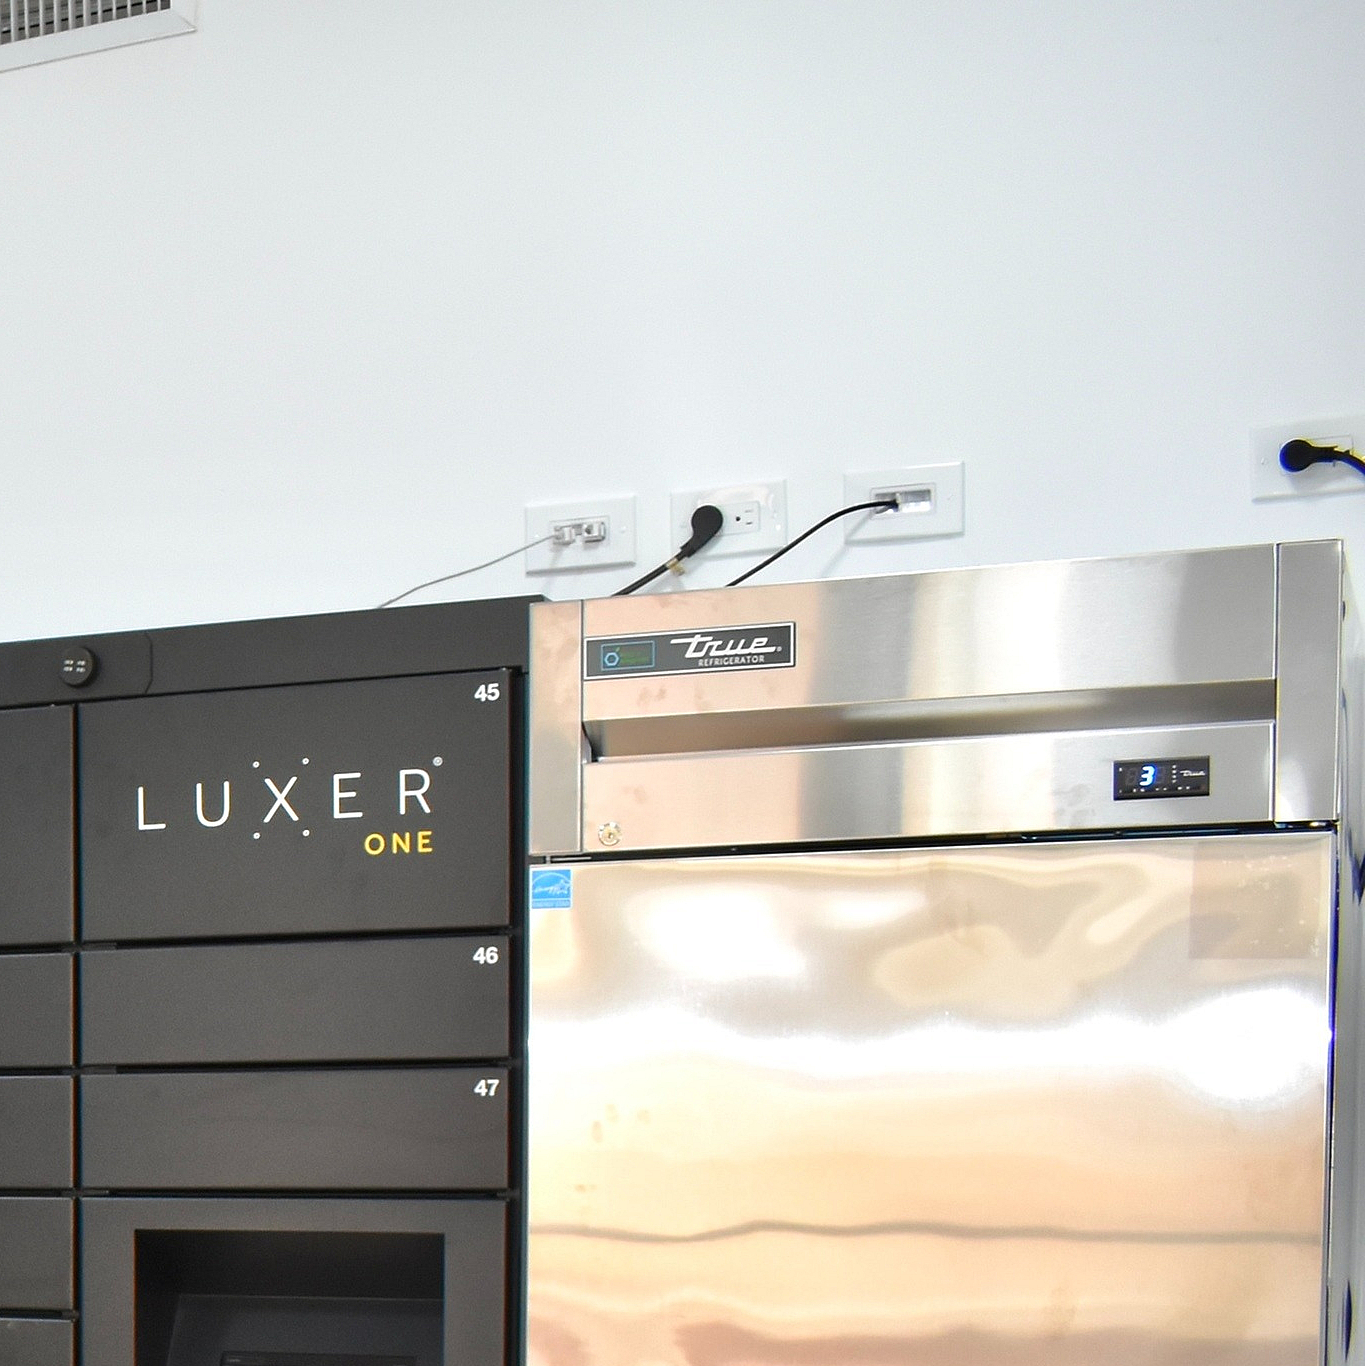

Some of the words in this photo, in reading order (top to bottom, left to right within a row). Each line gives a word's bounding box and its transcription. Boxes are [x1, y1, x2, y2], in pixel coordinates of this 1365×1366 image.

[697, 654, 766, 668] REFRIGERATOR
[473, 682, 501, 703] 45
[1138, 765, 1156, 787] 3
[136, 767, 433, 832] LUXER
[363, 830, 434, 856] ONE
[472, 945, 499, 965] 46
[473, 1078, 500, 1097] 47
